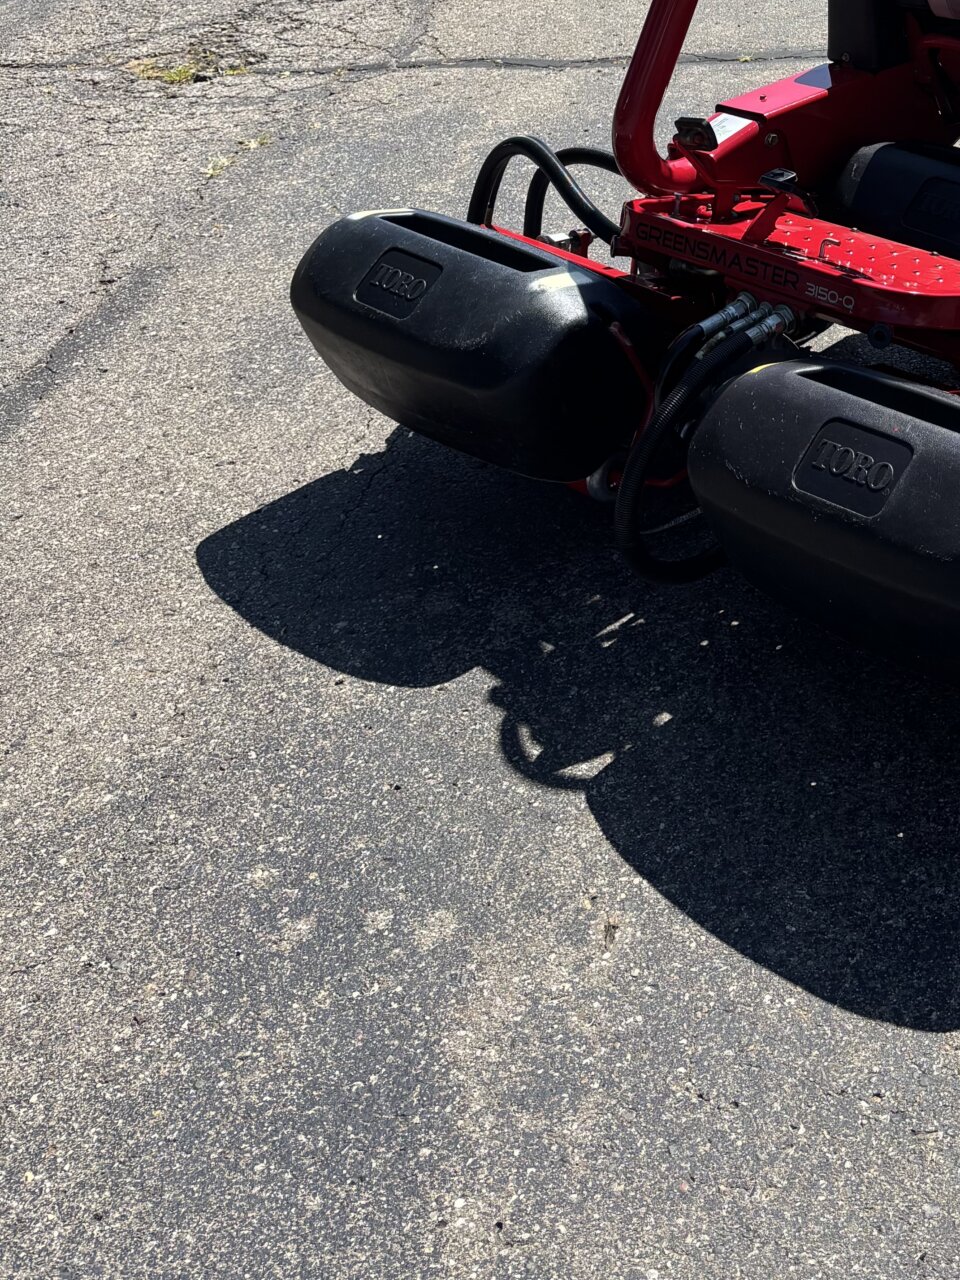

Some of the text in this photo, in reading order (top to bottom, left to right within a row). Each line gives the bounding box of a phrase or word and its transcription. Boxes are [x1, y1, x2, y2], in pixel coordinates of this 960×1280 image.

[635, 222, 800, 291] GREENSMASTER
[369, 263, 427, 300] TORO
[805, 282, 856, 313] 3150-Q
[812, 438, 895, 490] TORO
